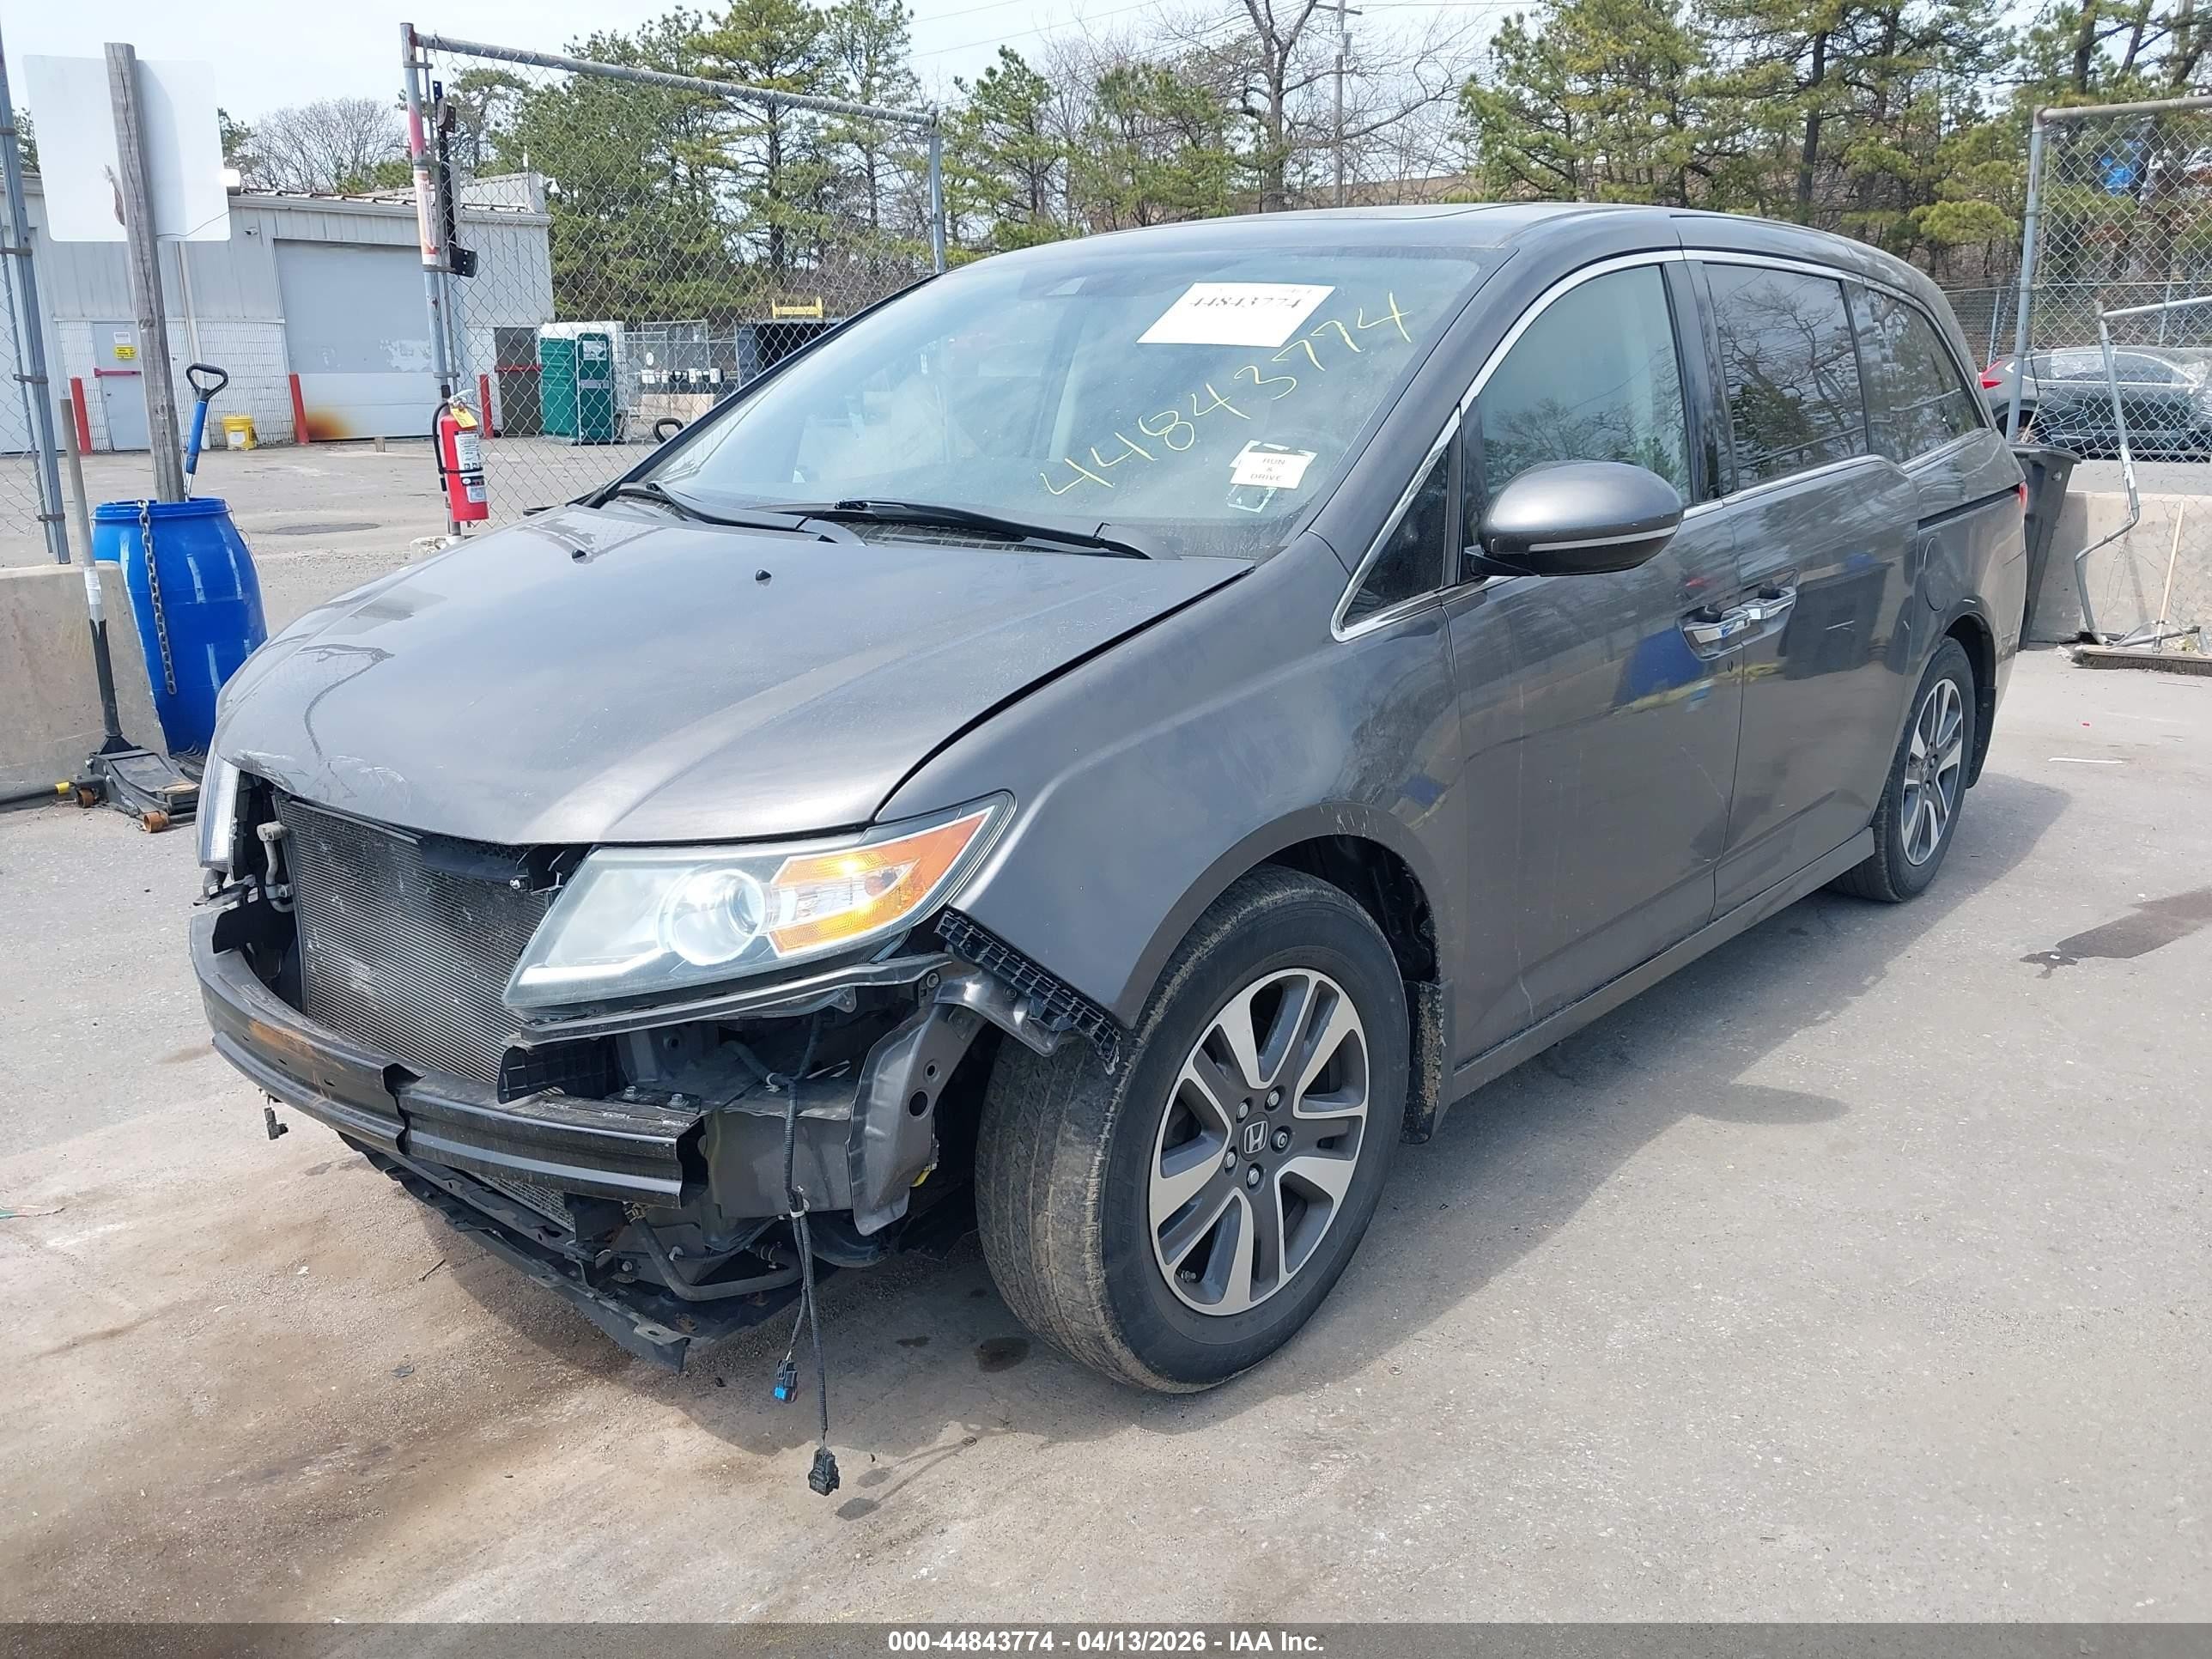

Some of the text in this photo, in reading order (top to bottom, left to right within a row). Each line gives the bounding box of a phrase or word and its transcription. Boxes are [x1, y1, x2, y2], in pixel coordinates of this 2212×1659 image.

[1188, 295, 1303, 310] 44843774
[1040, 290, 1413, 495] 44843774
[1249, 473, 1285, 482] DRIVE
